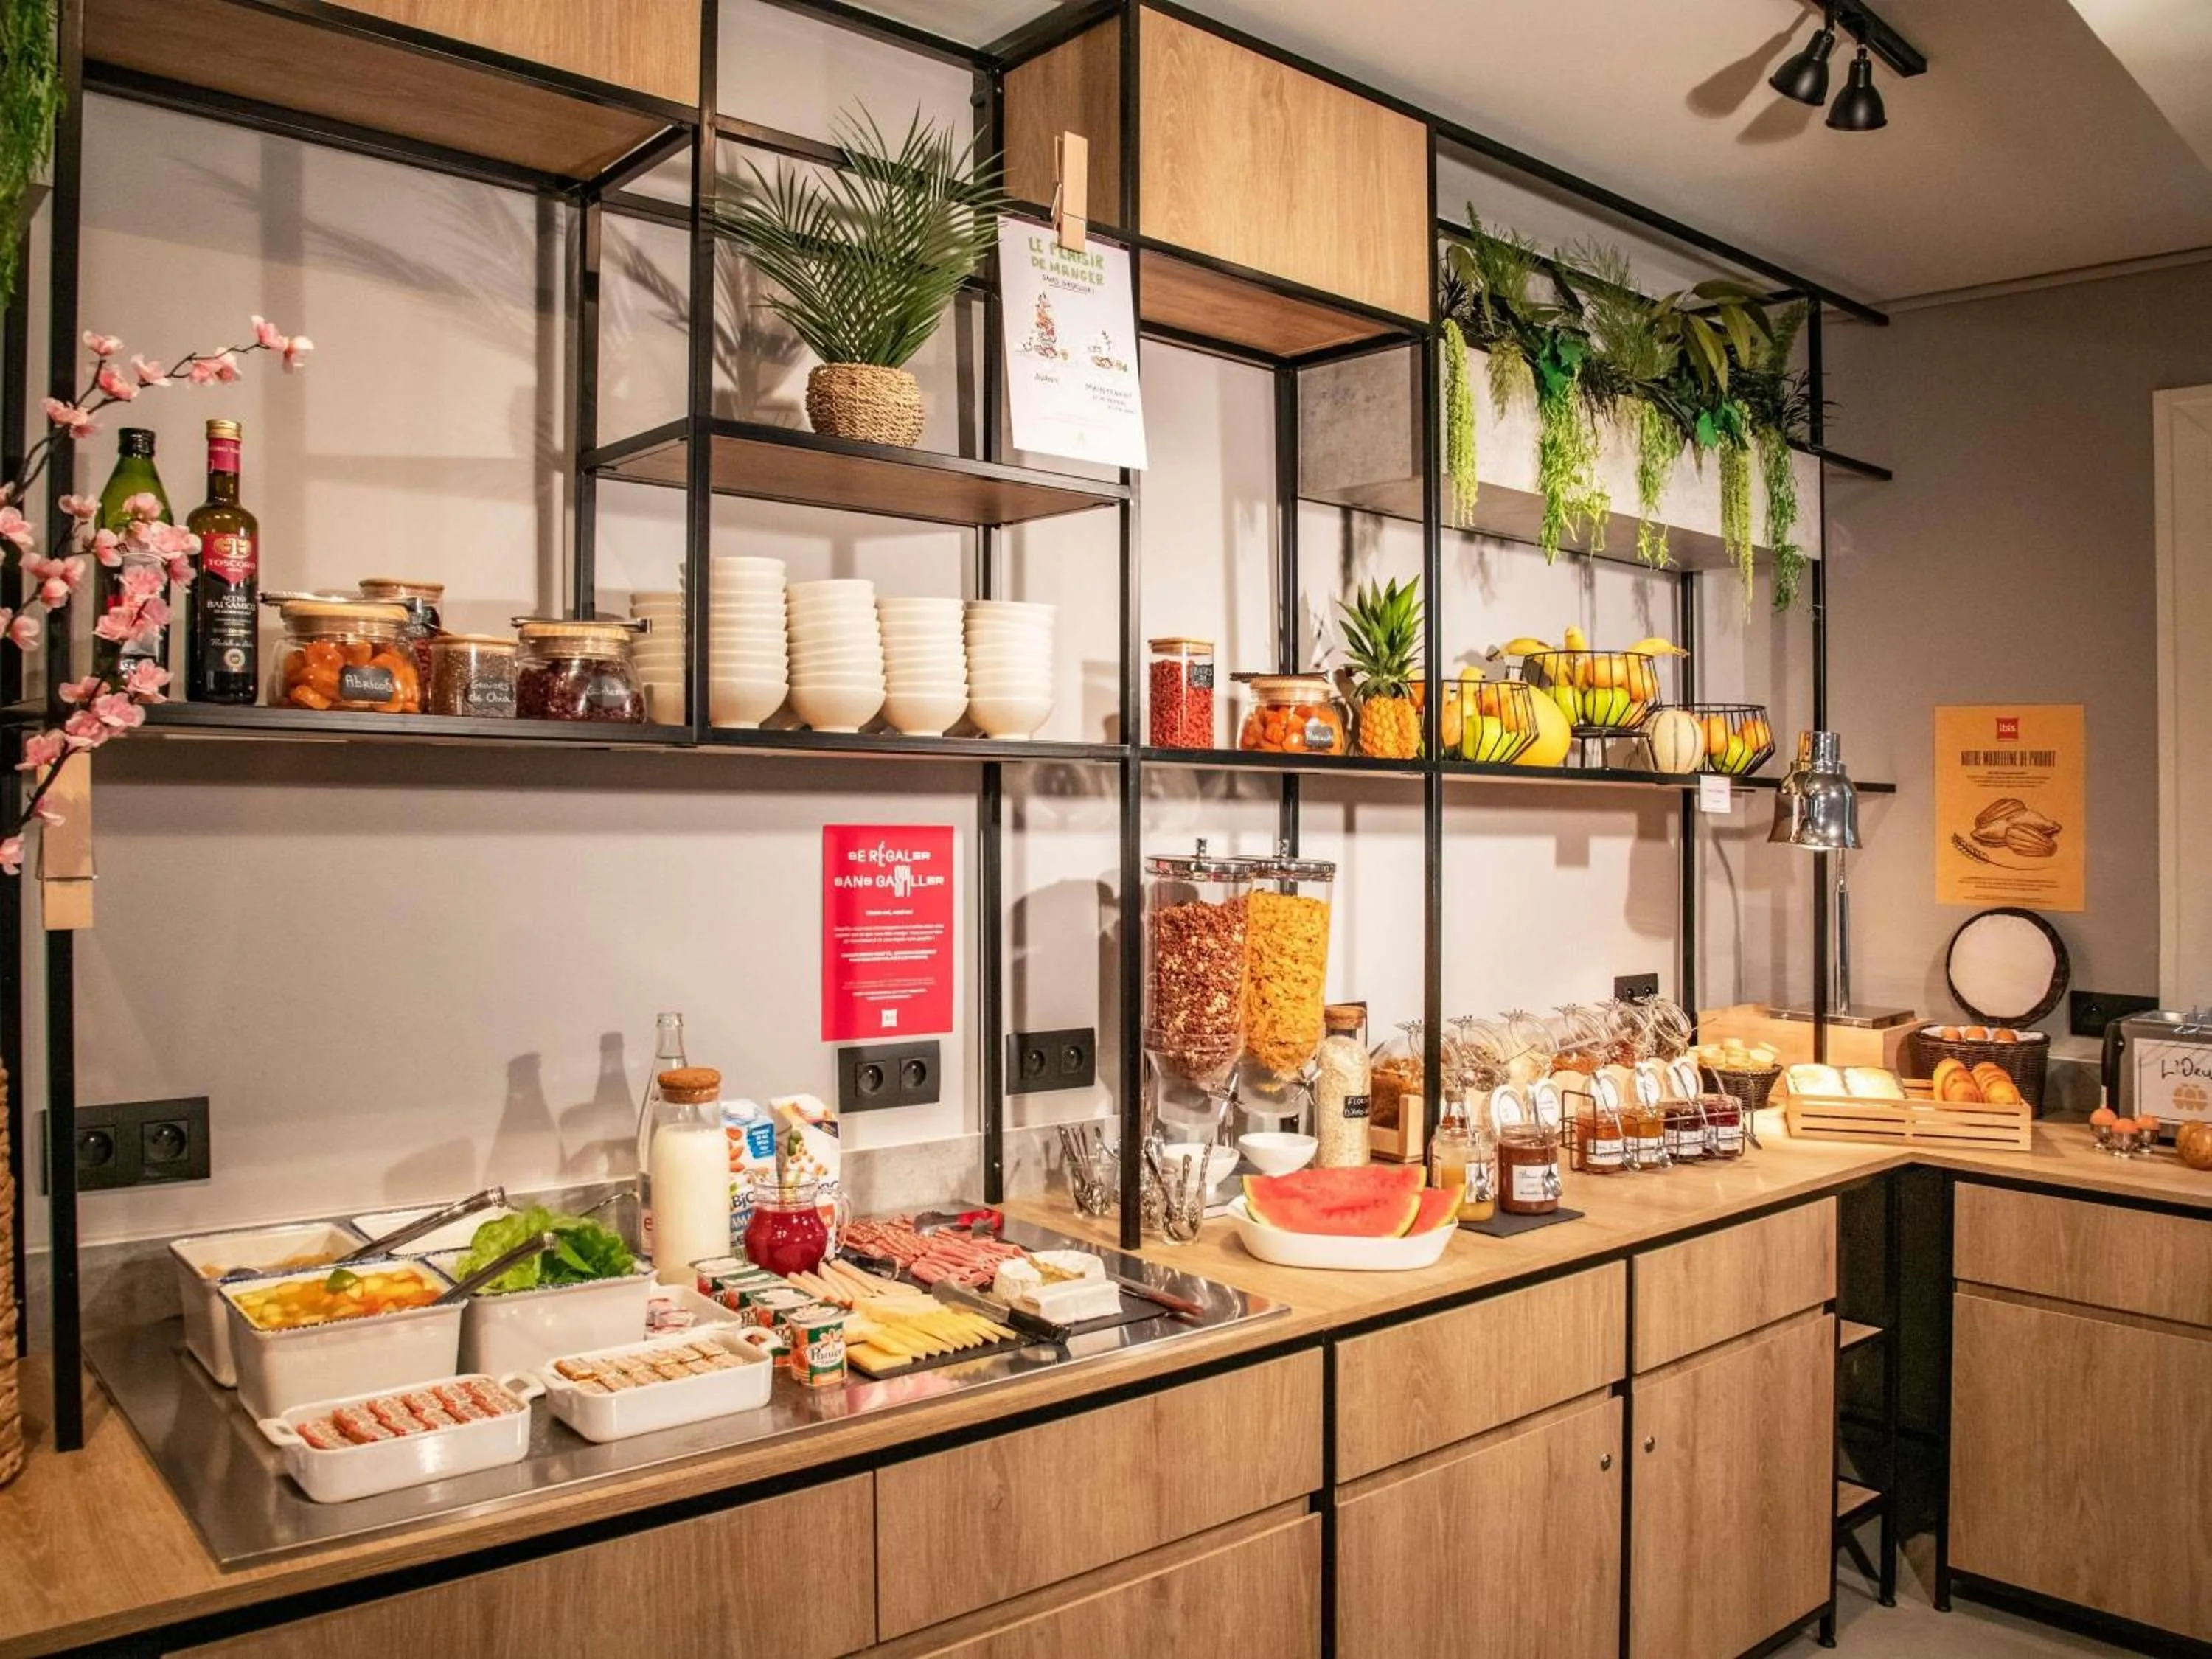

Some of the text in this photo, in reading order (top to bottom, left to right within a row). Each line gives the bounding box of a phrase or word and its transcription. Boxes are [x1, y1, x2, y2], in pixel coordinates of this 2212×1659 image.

[1028, 235, 1043, 254] LE
[1031, 256, 1105, 285] DE MANGER
[1999, 723, 2016, 732] ibis
